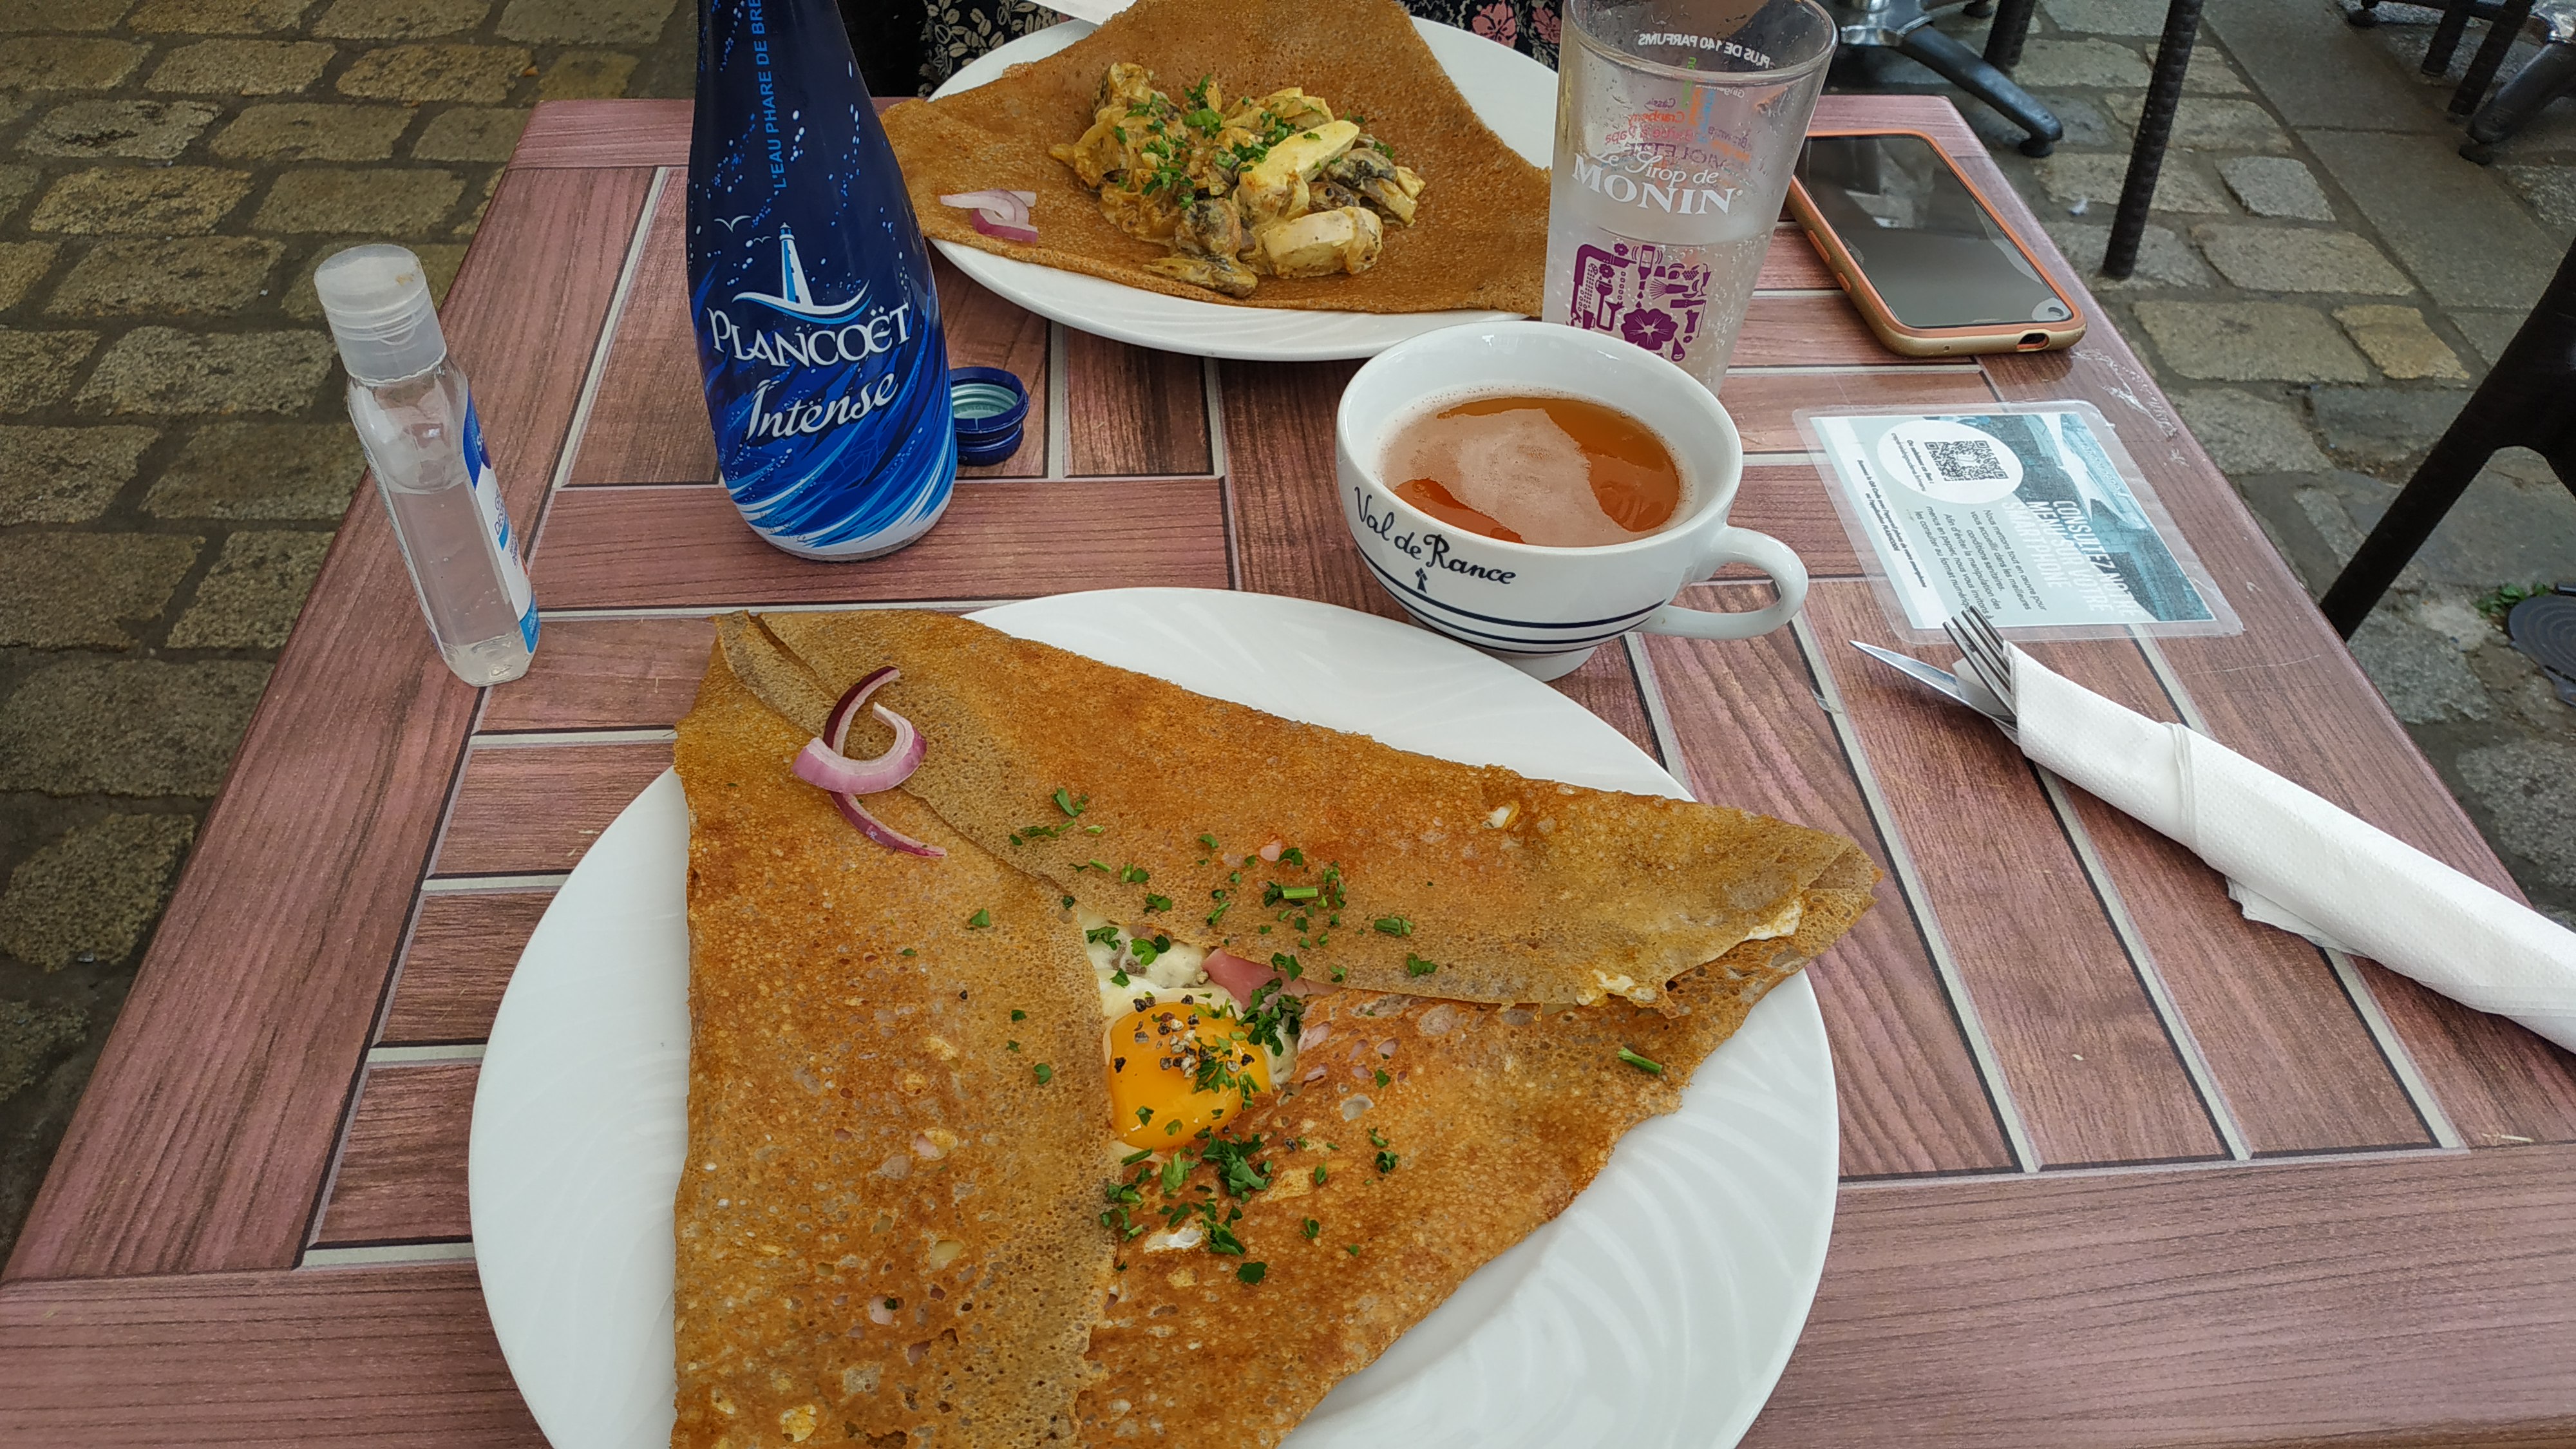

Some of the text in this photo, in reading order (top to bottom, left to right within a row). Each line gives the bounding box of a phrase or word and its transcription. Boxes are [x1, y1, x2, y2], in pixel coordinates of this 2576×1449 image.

[754, 41, 770, 65] DE
[758, 71, 779, 133] PHARE
[767, 139, 787, 187] L'EAU
[1572, 153, 1736, 215] MONIN
[1625, 151, 1694, 187] Sirop
[1692, 169, 1719, 184] de
[706, 302, 911, 367] PLANCOËT
[1354, 486, 1517, 585] Val de Rance
[1920, 521, 1939, 547] consulter
[1940, 558, 1955, 578] format
[1967, 530, 1988, 560] conditions
[2026, 501, 2069, 536] MENU
[2052, 501, 2116, 569] CONSULTEZ
[1926, 506, 1940, 526] menus
[1954, 558, 1966, 572] nous
[1963, 574, 1975, 588] vous
[1971, 590, 1989, 614] invitons
[1944, 514, 1955, 526] Afin
[1968, 558, 1994, 596] manipulation
[1991, 598, 2002, 609] des
[1971, 511, 1982, 525] vous
[1994, 553, 2007, 567] dans
[2009, 579, 2031, 609] meilleures
[1984, 510, 1996, 525] Nous
[1993, 527, 2011, 549] mettons
[2007, 551, 2020, 564] tout
[2030, 596, 2047, 611] pour
